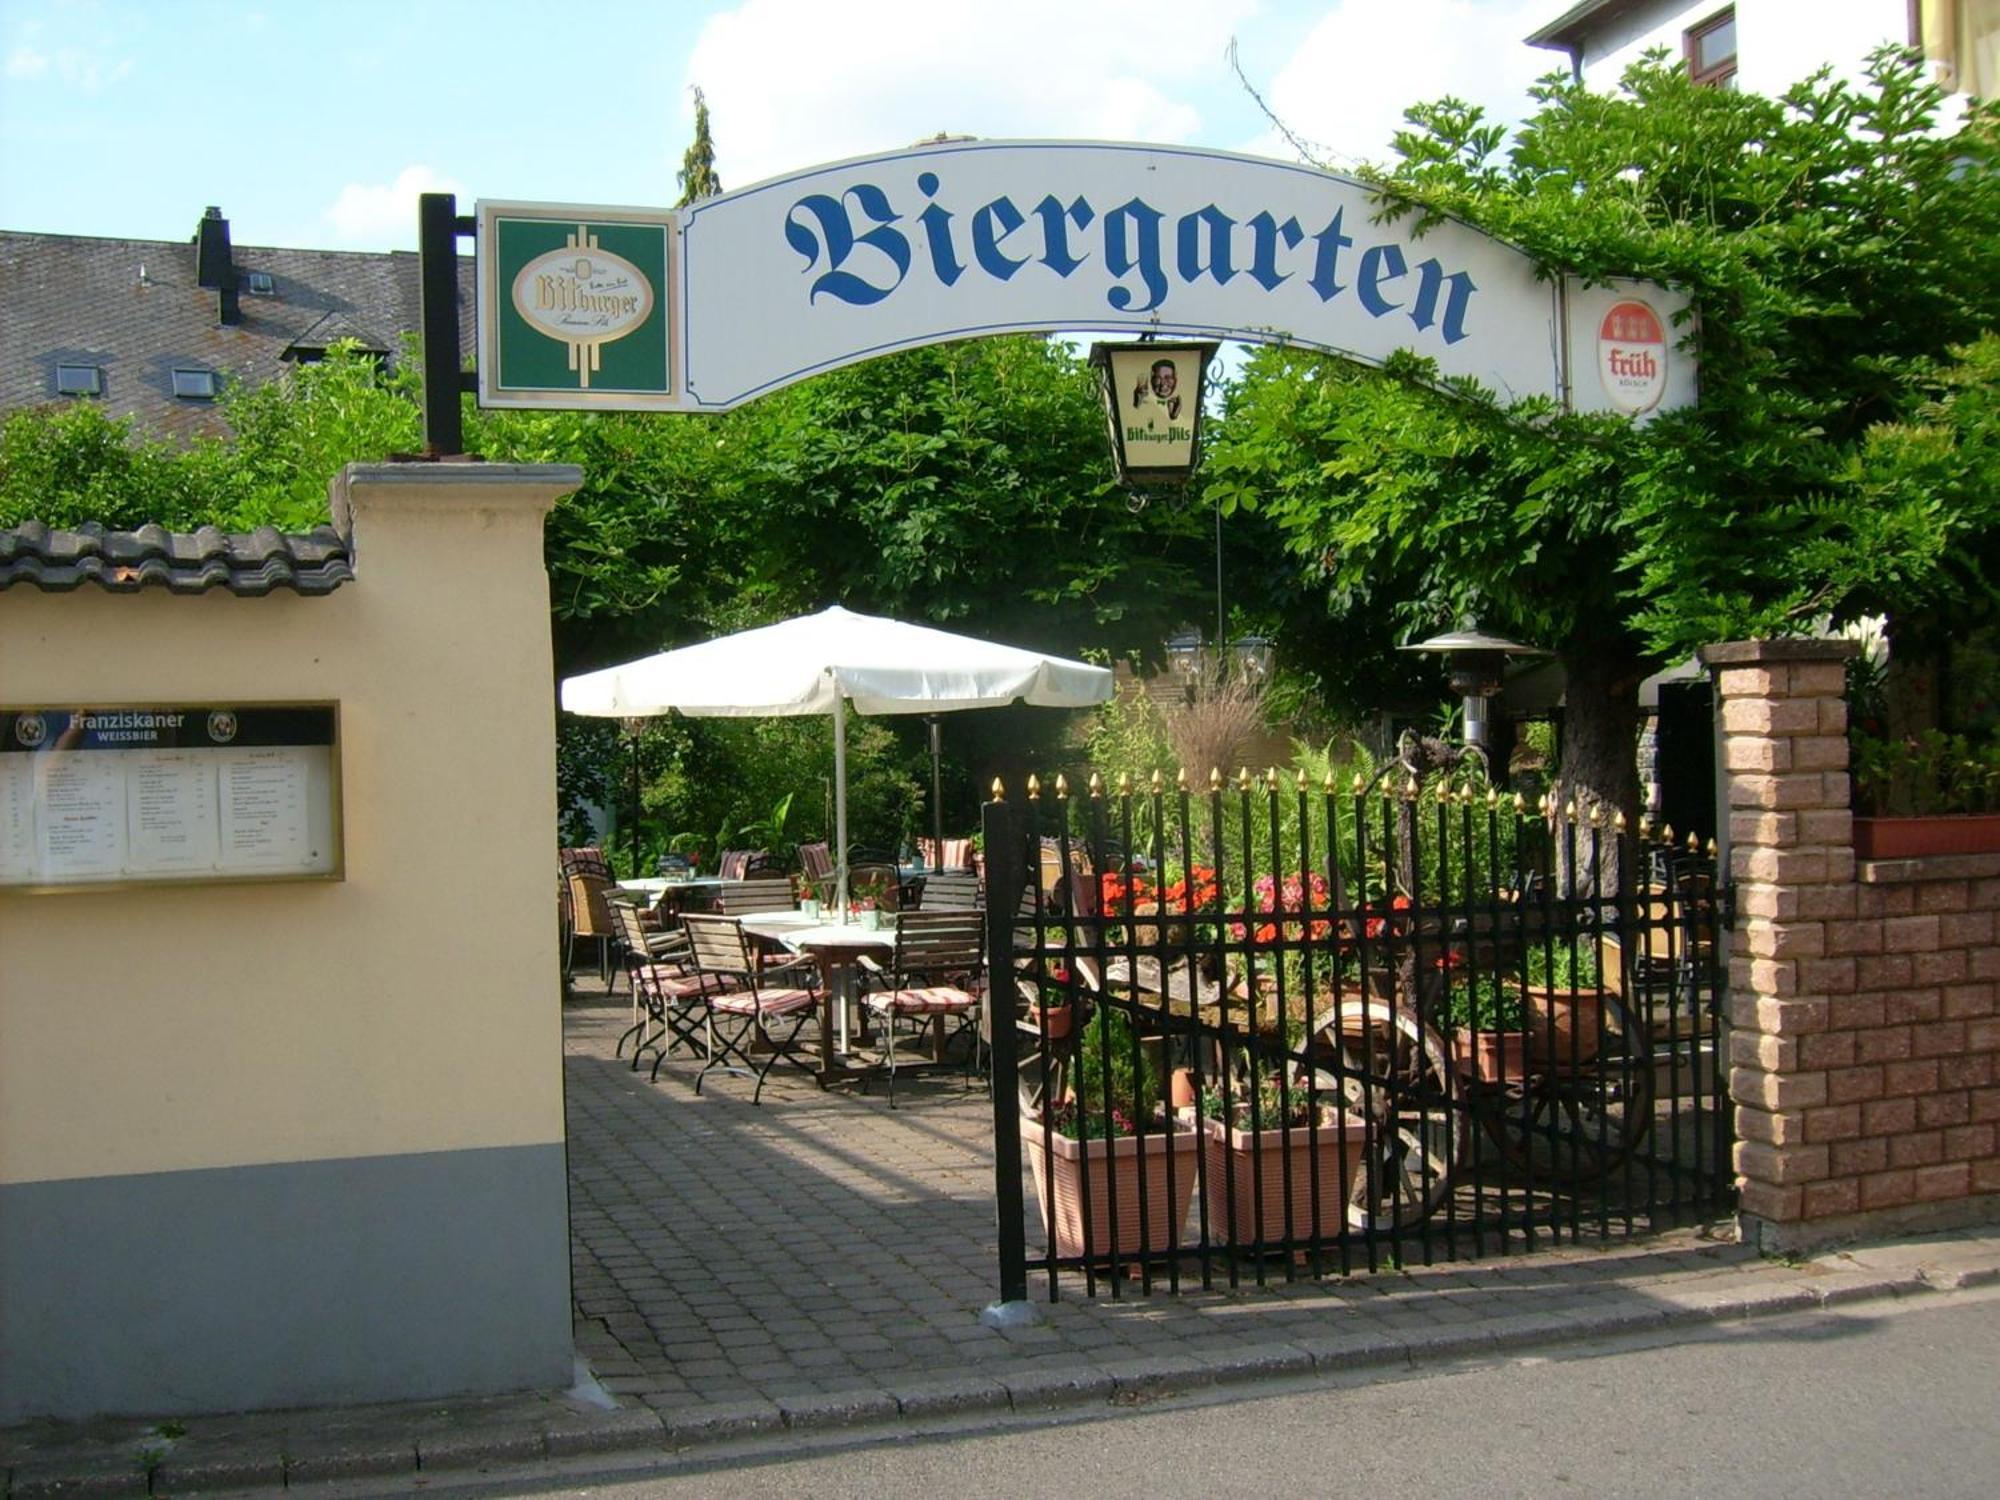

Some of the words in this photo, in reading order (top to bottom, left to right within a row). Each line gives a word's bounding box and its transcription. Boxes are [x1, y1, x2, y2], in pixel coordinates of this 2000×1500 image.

[785, 172, 1478, 345] Biergarten
[535, 274, 638, 319] Bitburger
[69, 712, 185, 729] Franziskaner
[97, 731, 158, 742] WEISSBIER
